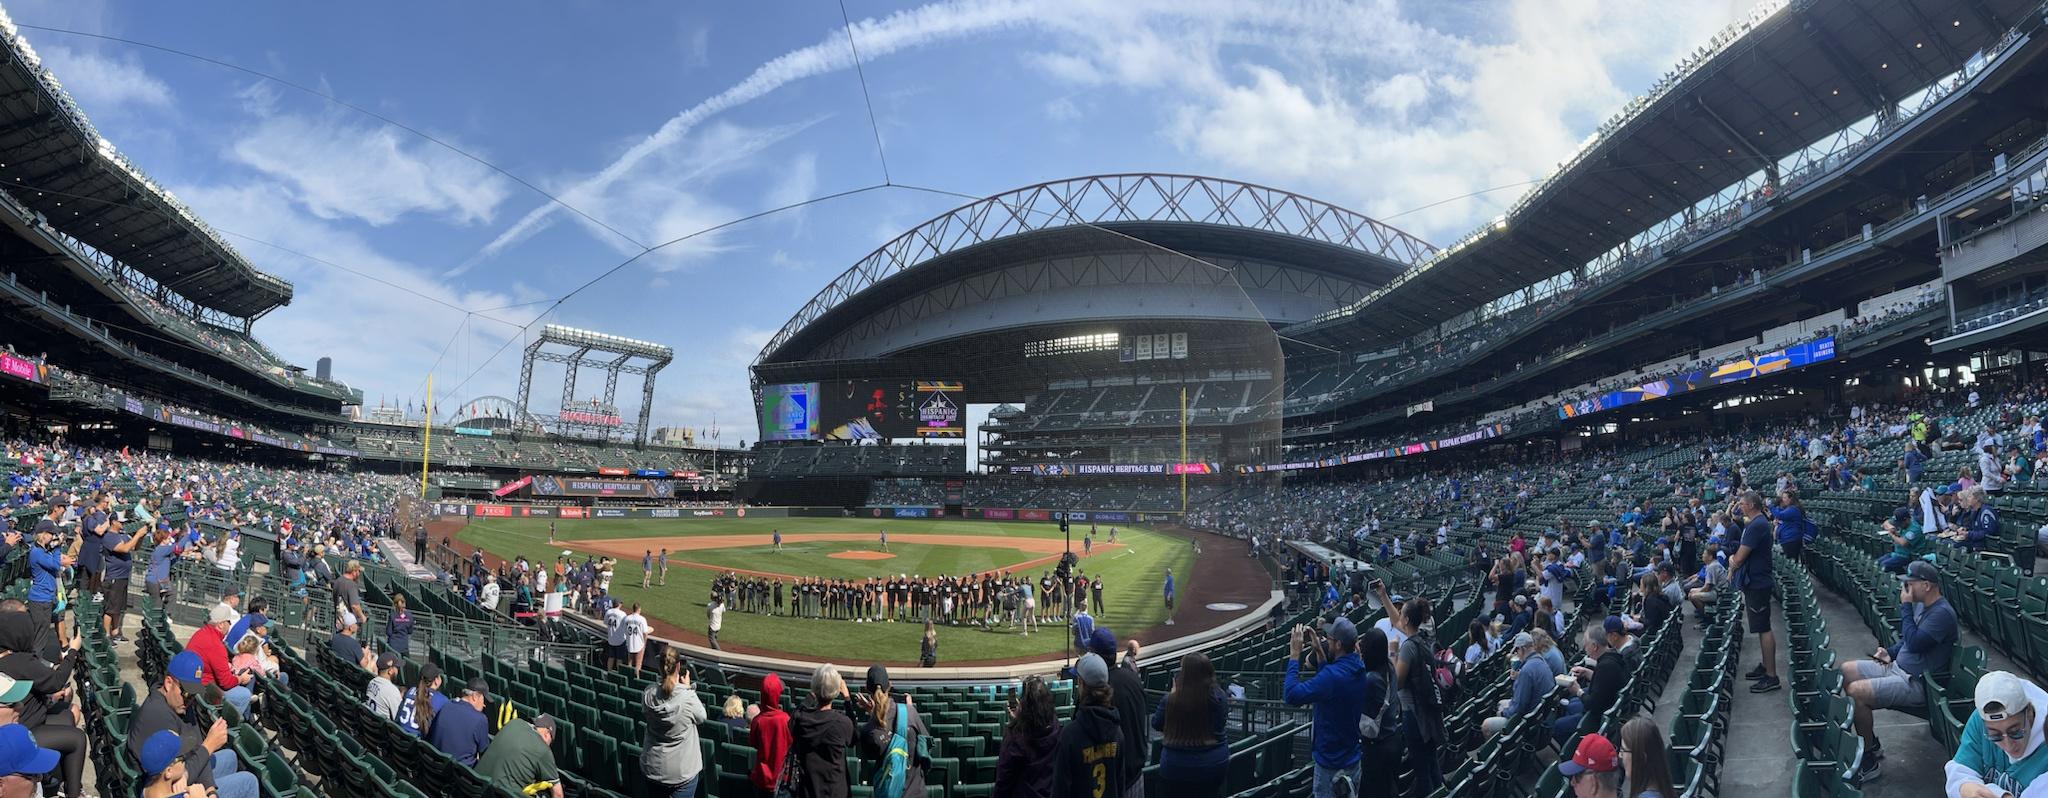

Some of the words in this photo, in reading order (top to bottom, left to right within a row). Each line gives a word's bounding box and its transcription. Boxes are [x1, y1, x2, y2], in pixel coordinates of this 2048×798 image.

[1440, 437, 1460, 448] HISPANIC
[1079, 465, 1114, 473] HISPANIC
[1115, 465, 1148, 473] HERITAGE
[1150, 464, 1163, 473] DAY
[604, 482, 630, 490] HERITAGE
[896, 509, 917, 518] Alaska
[1092, 763, 1106, 798] 3
